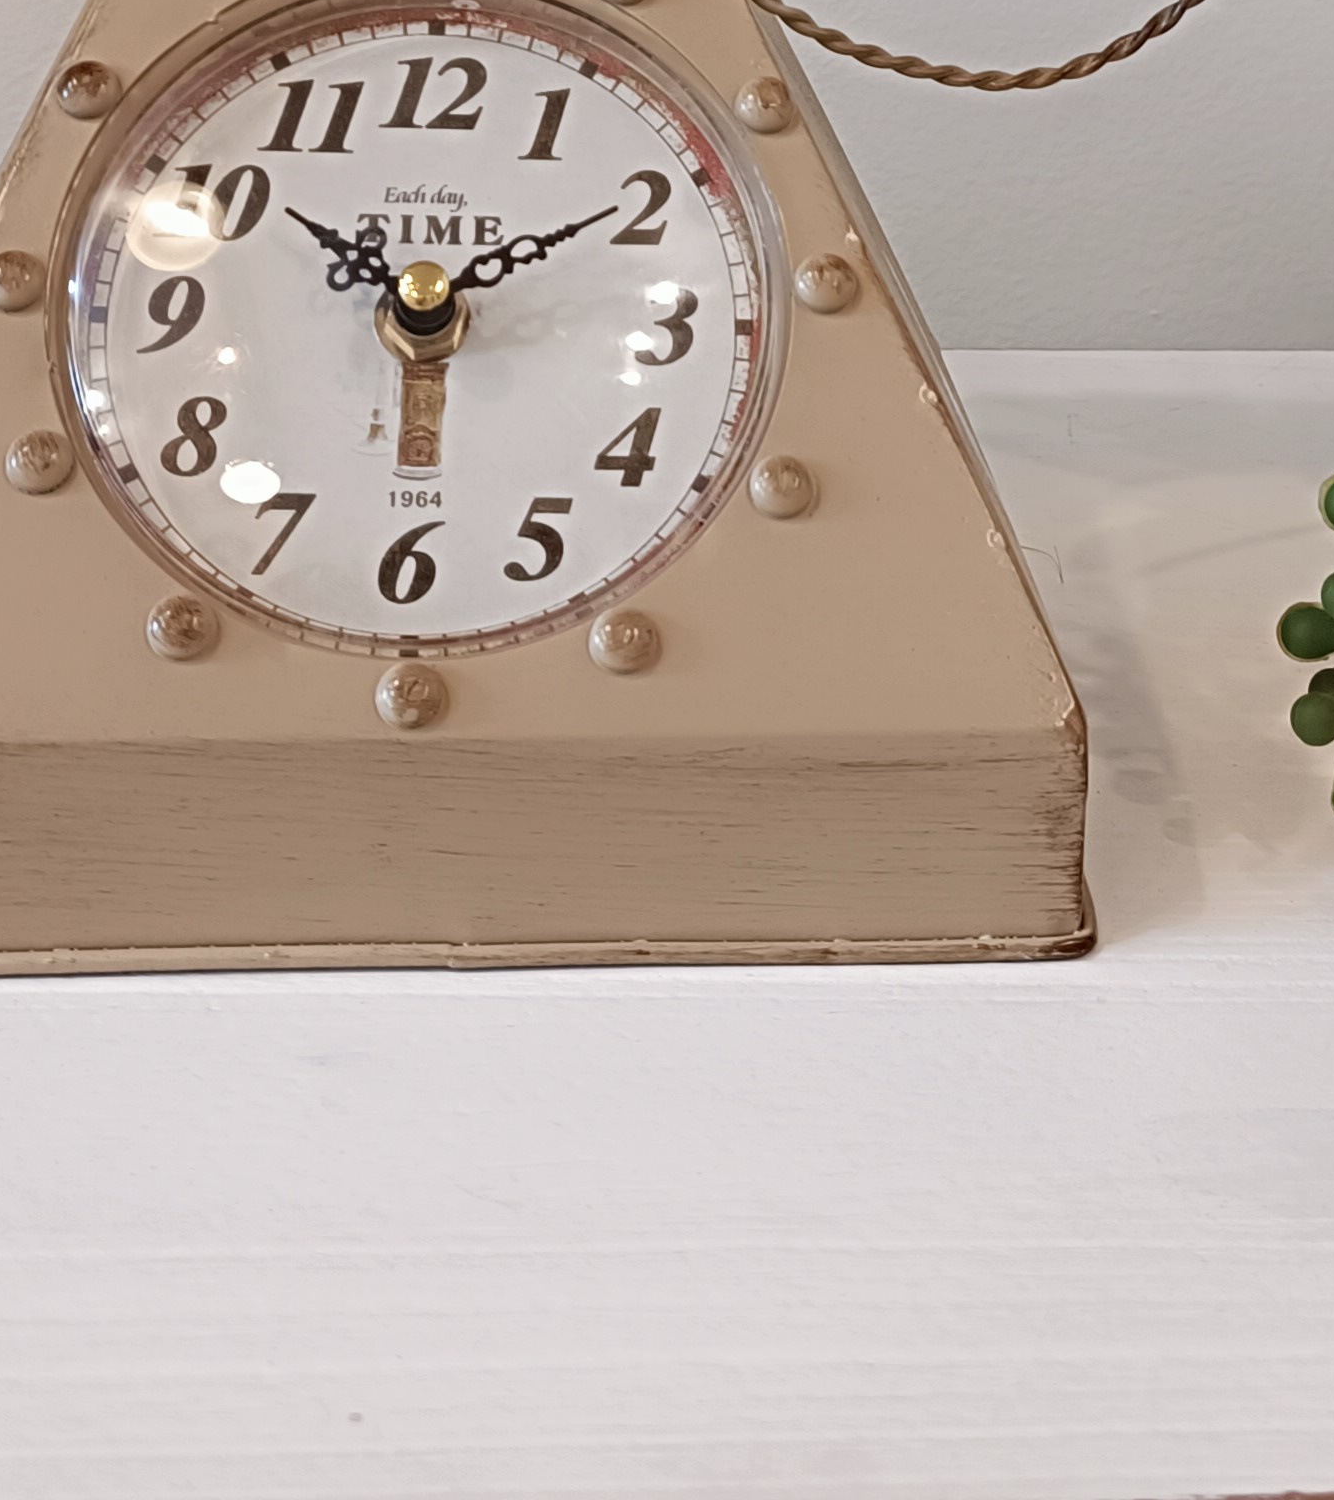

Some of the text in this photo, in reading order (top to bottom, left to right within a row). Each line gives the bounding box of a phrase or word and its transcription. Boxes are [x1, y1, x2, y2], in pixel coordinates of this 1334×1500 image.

[257, 79, 365, 155] 11
[378, 56, 488, 131] 12
[517, 87, 571, 161] 1
[357, 213, 504, 246] TIME
[384, 184, 468, 213] Each day,
[609, 169, 674, 246] 2
[135, 275, 206, 355] 9
[634, 286, 699, 366] 3
[159, 396, 228, 477] 8
[594, 407, 662, 488] 4
[251, 491, 317, 575] 7
[389, 490, 442, 508] 1964
[377, 521, 446, 605] 6
[503, 497, 573, 582] 5
